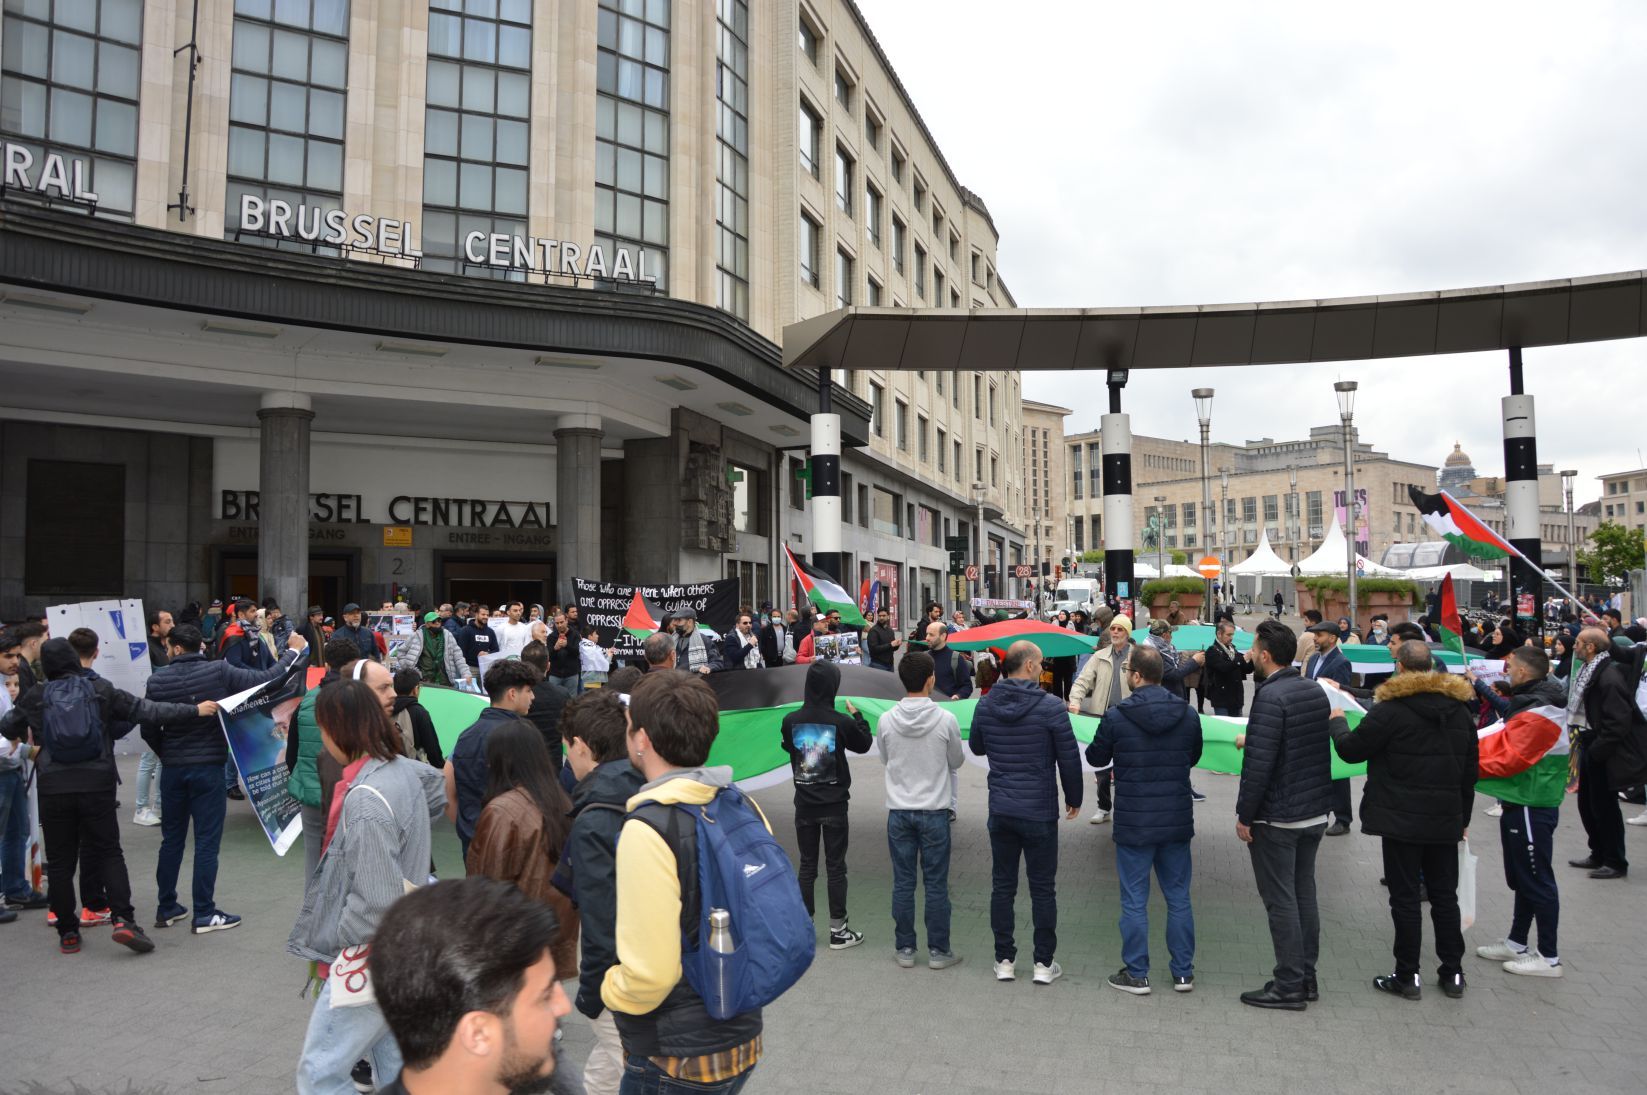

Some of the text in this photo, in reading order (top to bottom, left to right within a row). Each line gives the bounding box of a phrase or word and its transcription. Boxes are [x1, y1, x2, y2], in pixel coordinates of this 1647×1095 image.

[0, 141, 98, 201] RAL
[241, 195, 656, 282] BRUSSEL CENTRAAL
[222, 490, 557, 528] BRSEL CENTRAAL
[504, 534, 551, 545] INGANG
[392, 558, 405, 575] 2
[661, 585, 685, 597] when
